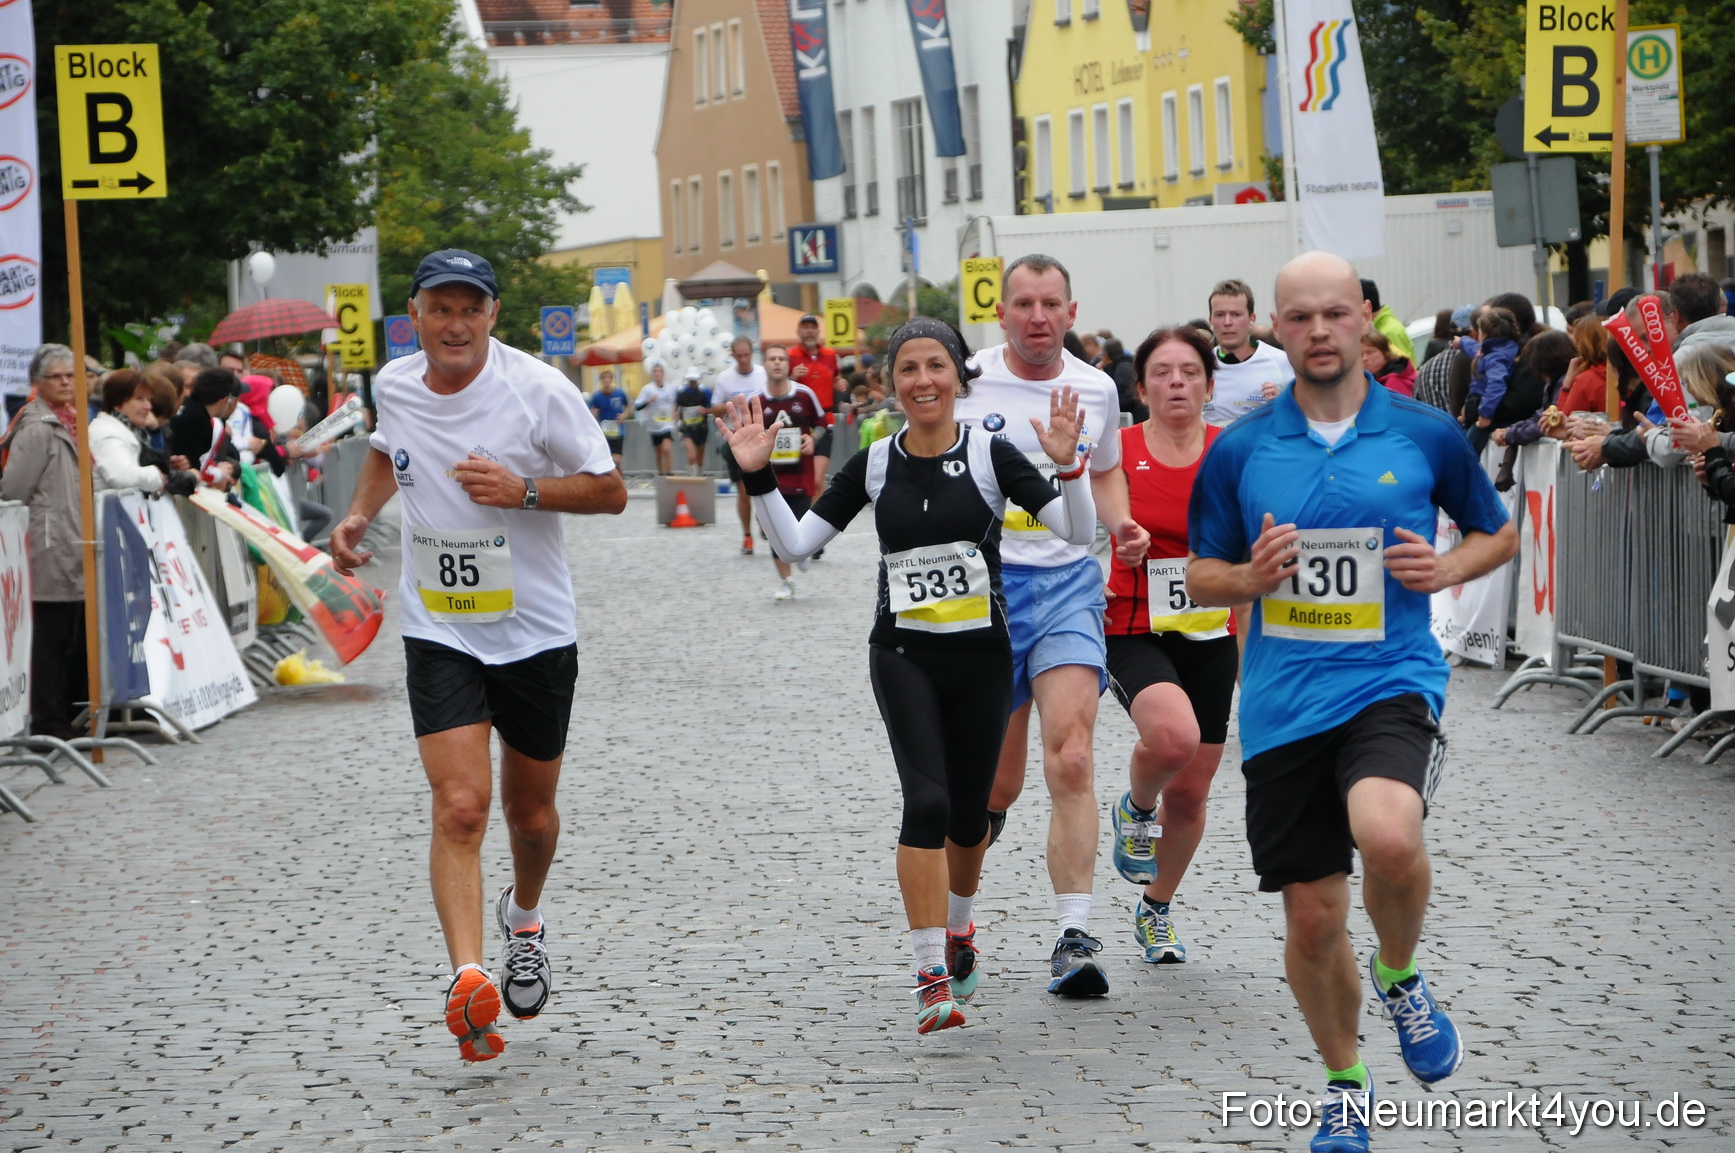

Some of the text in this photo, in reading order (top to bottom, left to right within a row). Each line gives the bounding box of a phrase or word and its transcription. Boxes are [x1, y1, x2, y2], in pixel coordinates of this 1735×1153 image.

[1540, 5, 1615, 31] Block
[68, 51, 148, 78] Block
[1638, 45, 1660, 69] H
[1551, 45, 1600, 117] B
[85, 92, 138, 164] B
[324, 244, 374, 254] eumarkt
[965, 262, 1000, 273] Block
[973, 277, 995, 308] C
[828, 300, 854, 309] Block
[337, 303, 359, 334] C
[833, 313, 849, 335] D
[1618, 325, 1672, 397] Audi BKK
[413, 534, 490, 549] PARTL Neumarkt
[1301, 540, 1361, 550] Neumarkt
[438, 553, 480, 587] 85
[918, 553, 966, 566] Neumarkt
[906, 565, 970, 602] 533
[1149, 567, 1181, 577] PARTL
[446, 596, 477, 610] Toni
[1289, 606, 1352, 625] Andreas
